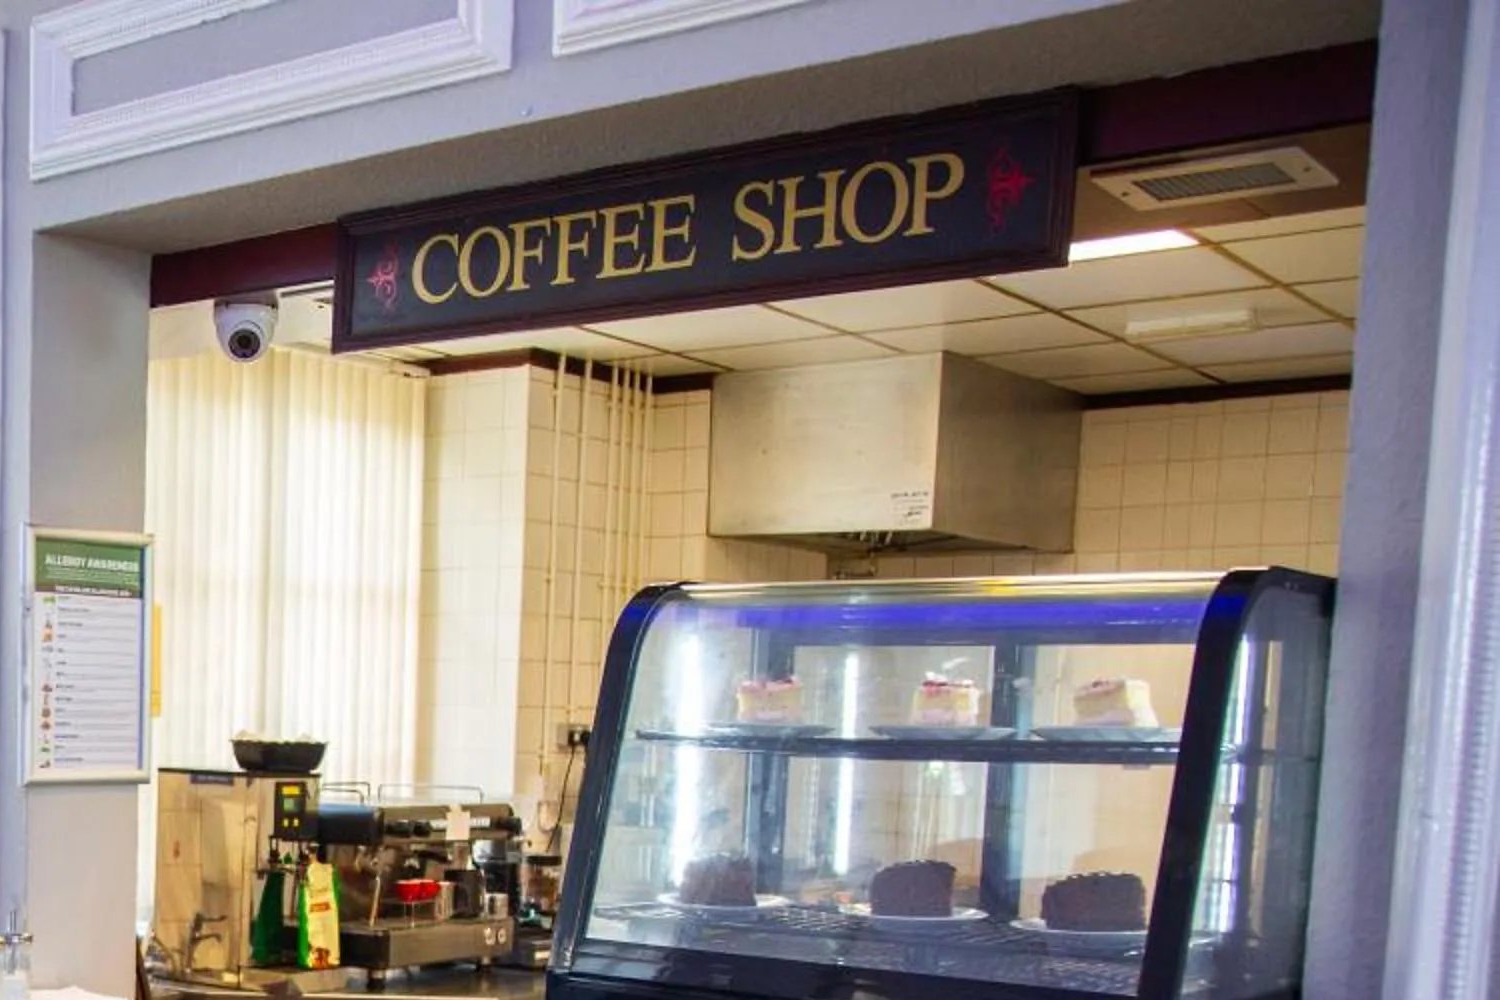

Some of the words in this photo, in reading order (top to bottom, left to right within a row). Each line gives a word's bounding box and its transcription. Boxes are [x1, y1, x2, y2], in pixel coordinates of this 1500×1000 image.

[412, 193, 697, 305] COFFEE
[732, 152, 965, 262] SHOP
[45, 553, 85, 568] ALLERGY
[86, 557, 140, 572] AWARENESS
